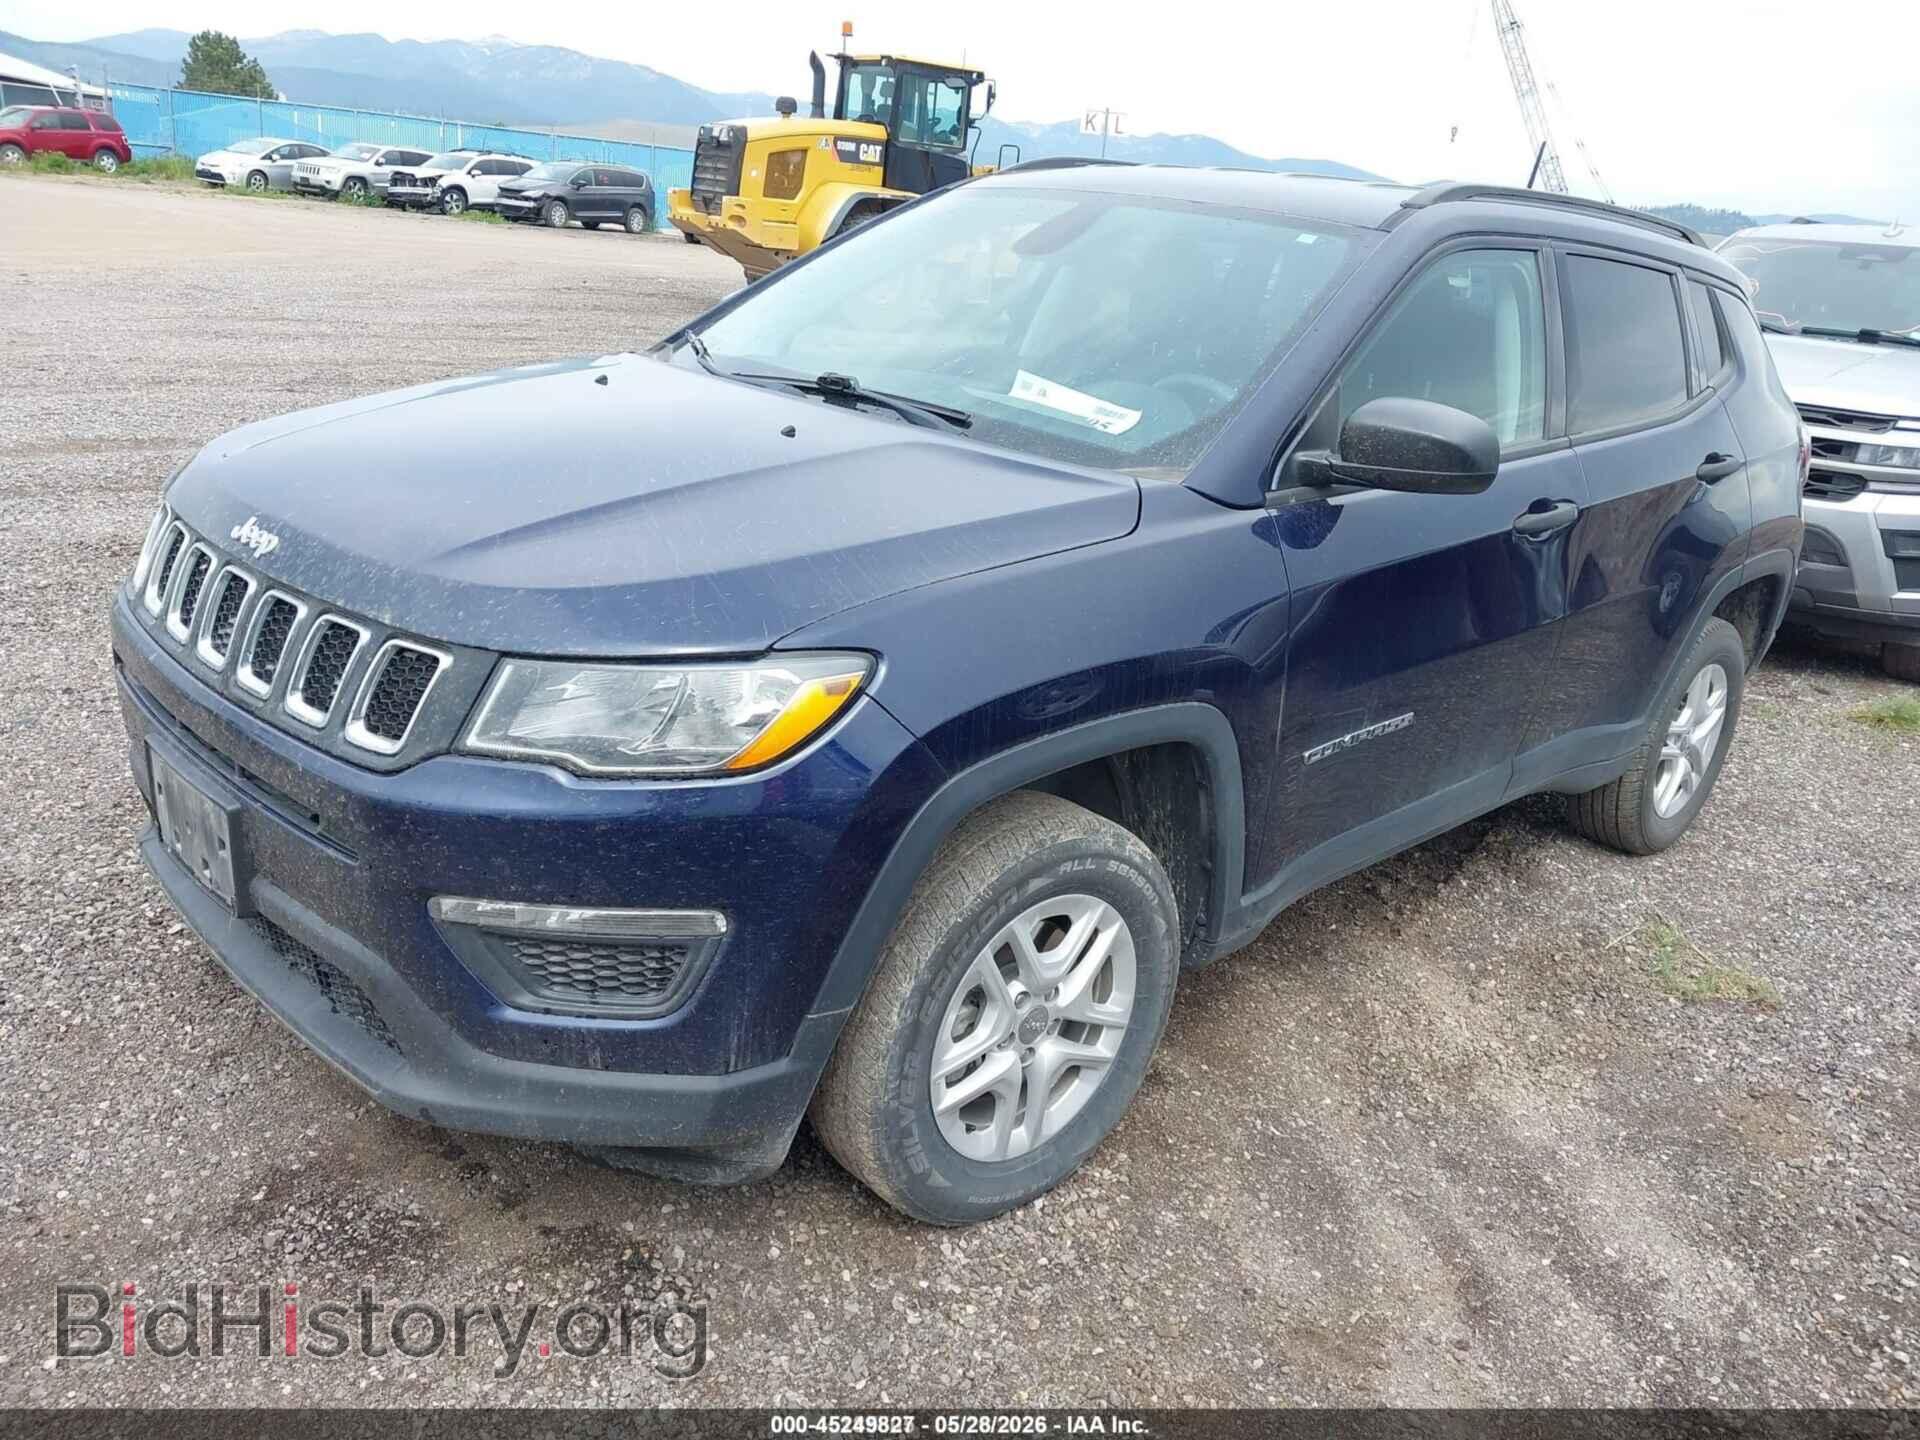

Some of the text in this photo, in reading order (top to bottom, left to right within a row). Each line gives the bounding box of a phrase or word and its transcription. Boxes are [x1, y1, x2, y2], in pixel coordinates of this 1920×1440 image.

[1084, 113, 1125, 134] K L
[859, 143, 882, 162] CAT
[231, 516, 279, 558] Jeep
[1058, 857, 1097, 875] ALL
[1106, 860, 1160, 905] SEASON
